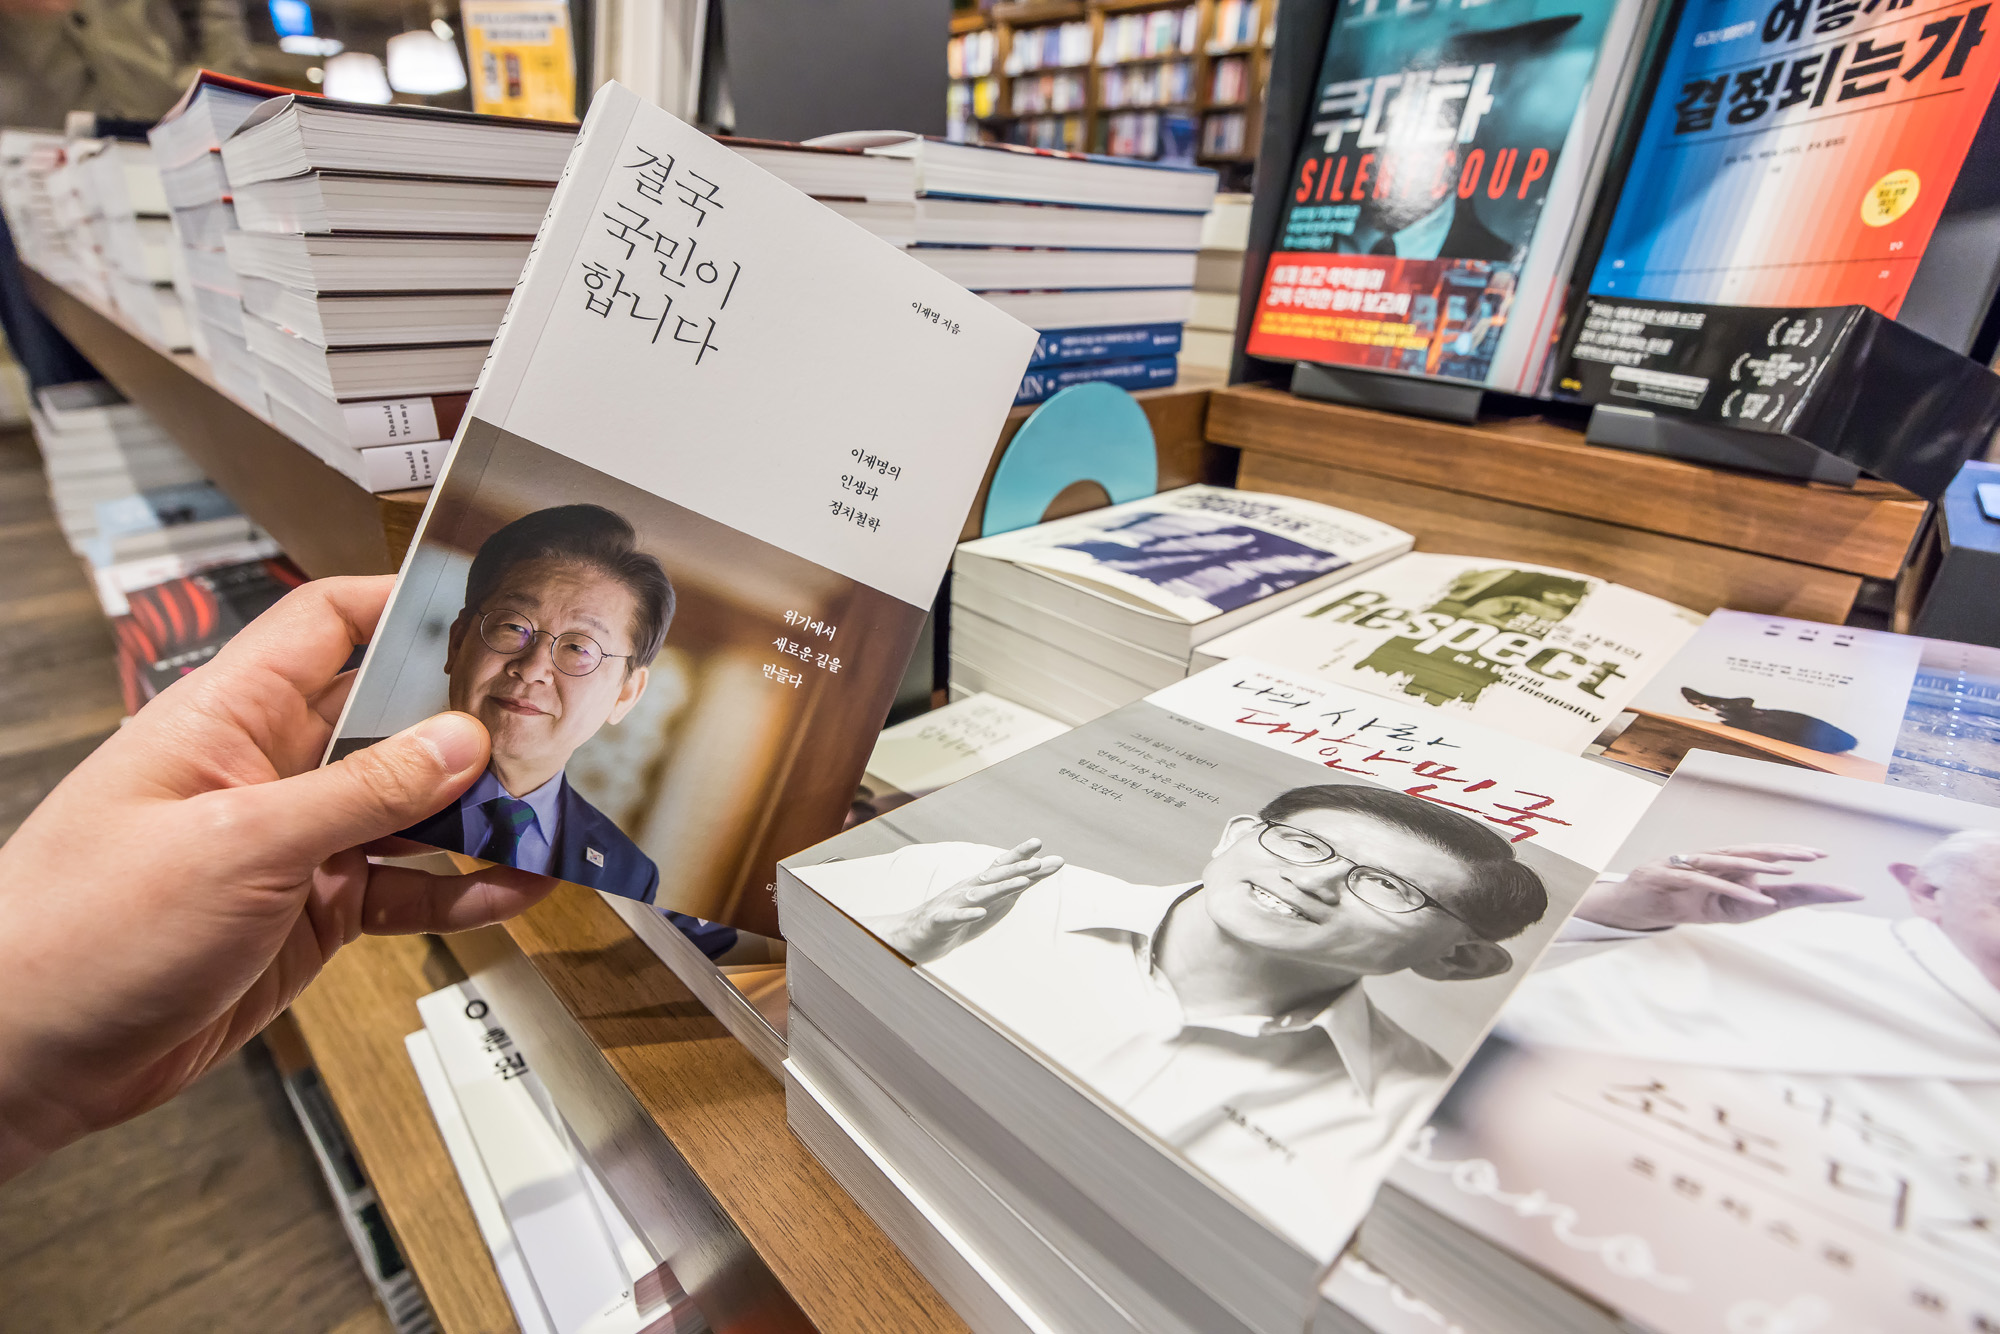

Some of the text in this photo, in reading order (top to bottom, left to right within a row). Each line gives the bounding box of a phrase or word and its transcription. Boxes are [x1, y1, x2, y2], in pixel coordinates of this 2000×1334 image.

[1674, 2, 1993, 135] 결정되는가
[1311, 62, 1497, 153] 쿠데타
[622, 145, 724, 227] 결국
[1295, 147, 1550, 203] SILEN COUP
[602, 202, 741, 310] 국민이
[581, 261, 718, 365] 합니다
[911, 301, 961, 335] 이재명 지음
[383, 405, 397, 438] Donald
[400, 404, 411, 436] Trump
[404, 451, 418, 482] Donald
[421, 449, 432, 480] Trump
[851, 448, 902, 481] 이재명의
[841, 474, 879, 501] 인생과
[828, 499, 881, 533] 정치철학
[783, 609, 837, 642] 위기에서
[772, 637, 842, 674] 새로운 길을
[1302, 590, 1626, 700] Respect
[762, 663, 803, 688] 만들다
[1453, 652, 1545, 688] in a World
[1232, 680, 1311, 709] 나의
[1320, 708, 1461, 752] 사랑
[1501, 677, 1602, 724] of Inequality
[1113, 740, 1177, 770] 가리키는 곳은
[1130, 732, 1219, 769] 그의 삶의 나침반이
[1058, 767, 1122, 802] 향하고 있었다.
[1077, 758, 1187, 809] 힘없고 소외된 사람들을
[1097, 749, 1220, 805] 언제나 가장 낮은 곳이었다.
[1235, 707, 1573, 844] 대한민국
